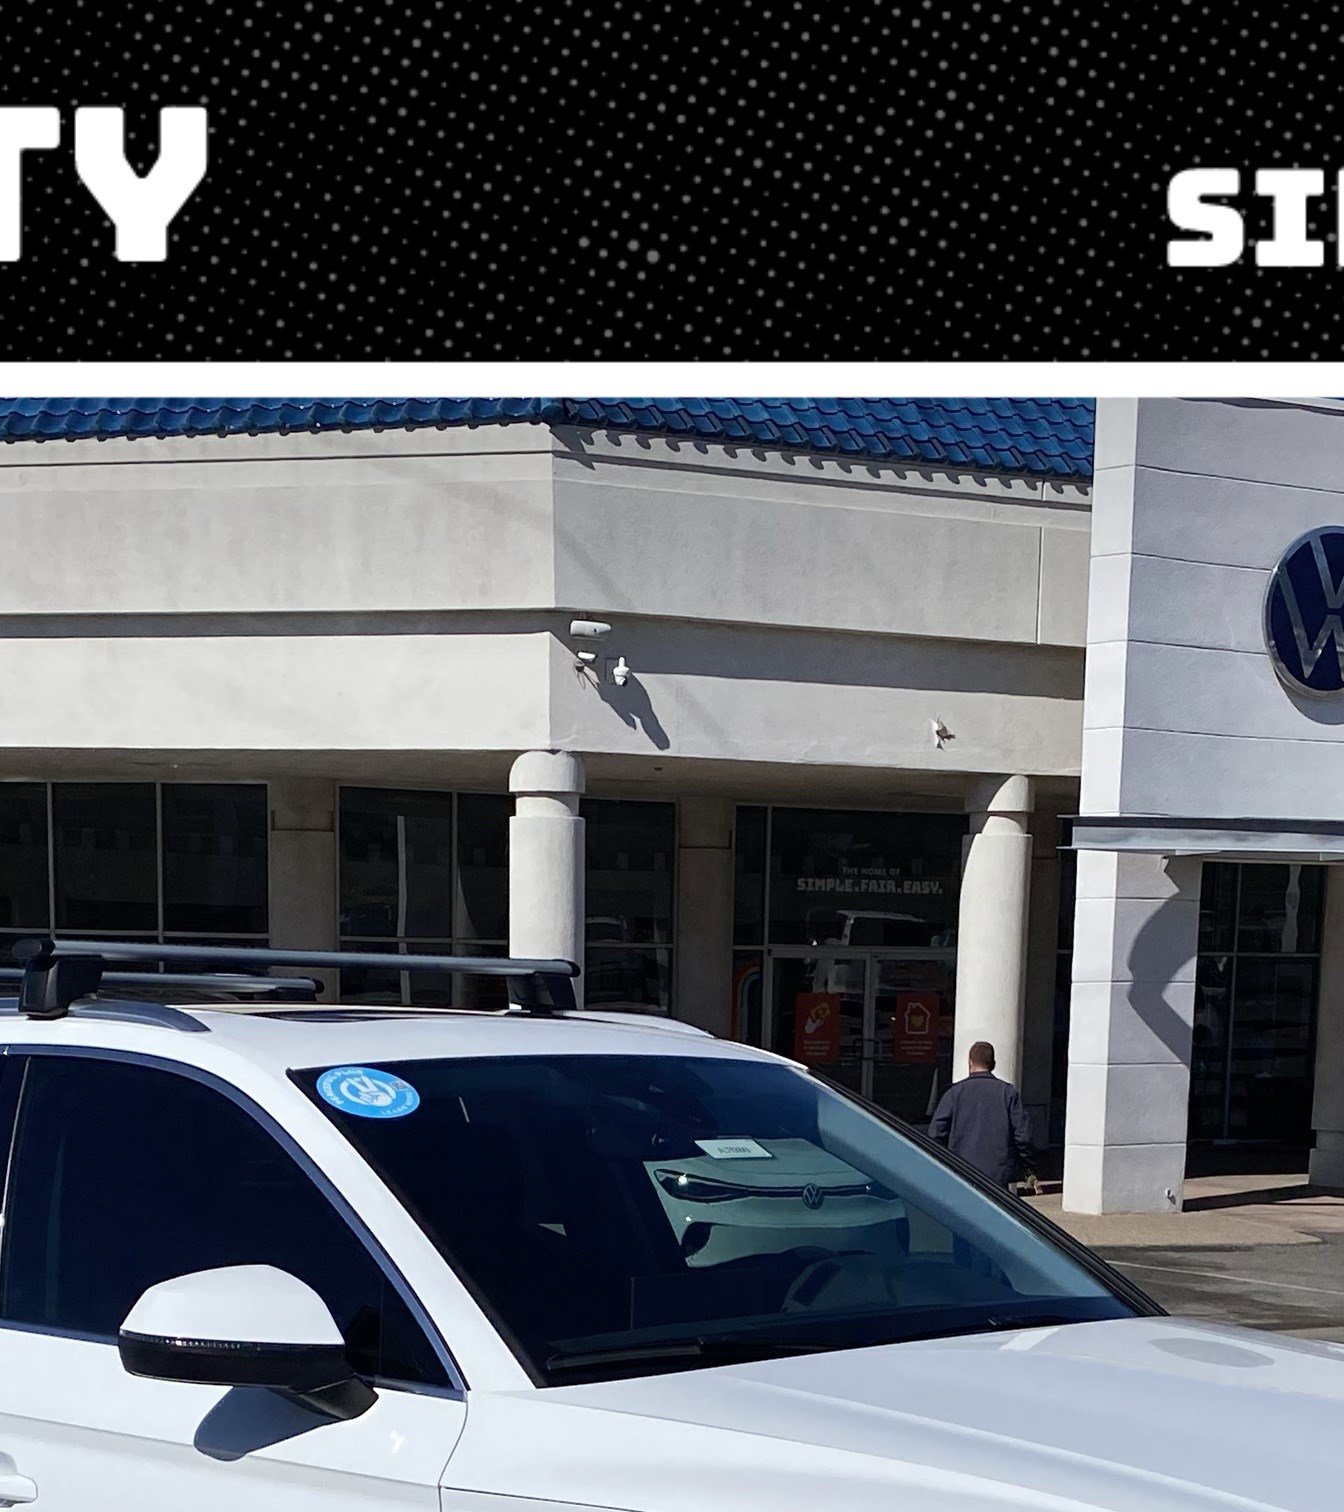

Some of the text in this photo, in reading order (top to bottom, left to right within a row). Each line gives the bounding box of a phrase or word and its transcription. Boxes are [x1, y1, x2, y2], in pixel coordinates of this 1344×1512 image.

[842, 866, 859, 875] THE
[861, 867, 886, 876] HOME
[797, 878, 944, 893] SIMPLE.FAIR.EASY.
